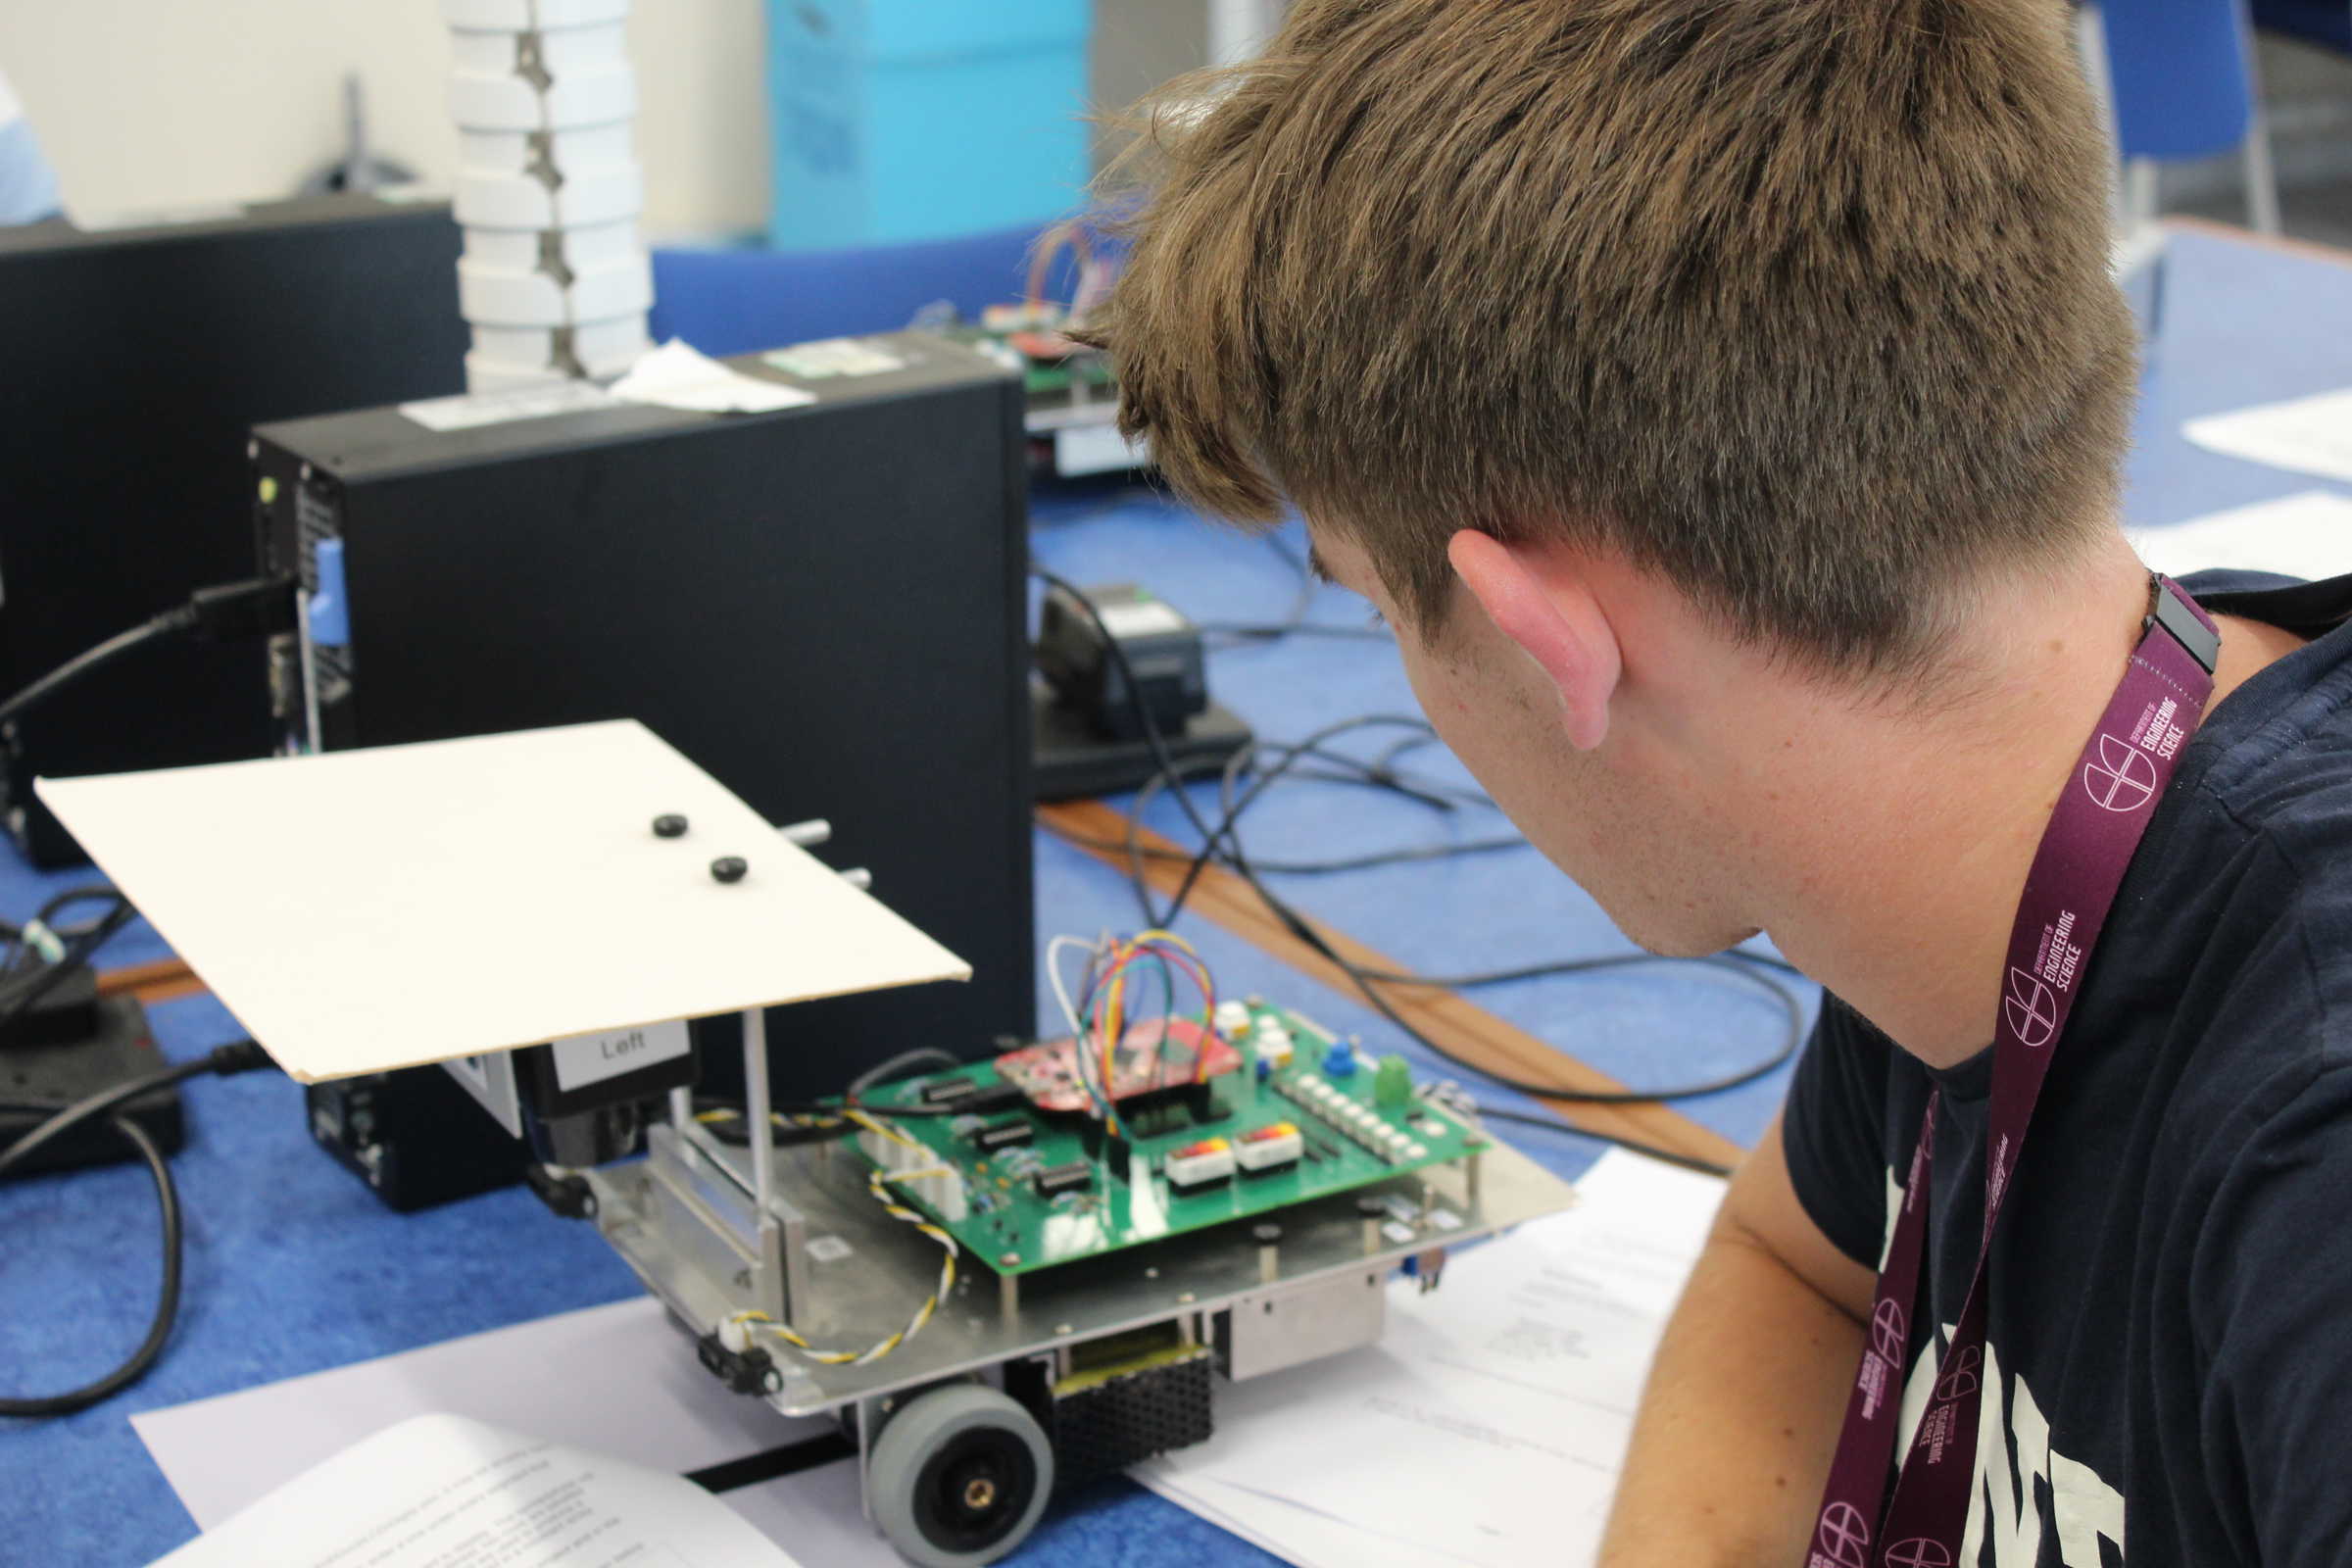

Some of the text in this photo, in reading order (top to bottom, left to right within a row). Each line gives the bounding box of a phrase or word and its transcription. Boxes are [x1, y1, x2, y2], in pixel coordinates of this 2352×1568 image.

[2140, 696, 2178, 752] ENGINEERING
[2157, 723, 2184, 760] SCIENCE
[2043, 909, 2076, 983] ENGINEERING
[2056, 943, 2082, 993] SCIENCE
[601, 1031, 646, 1059] Left
